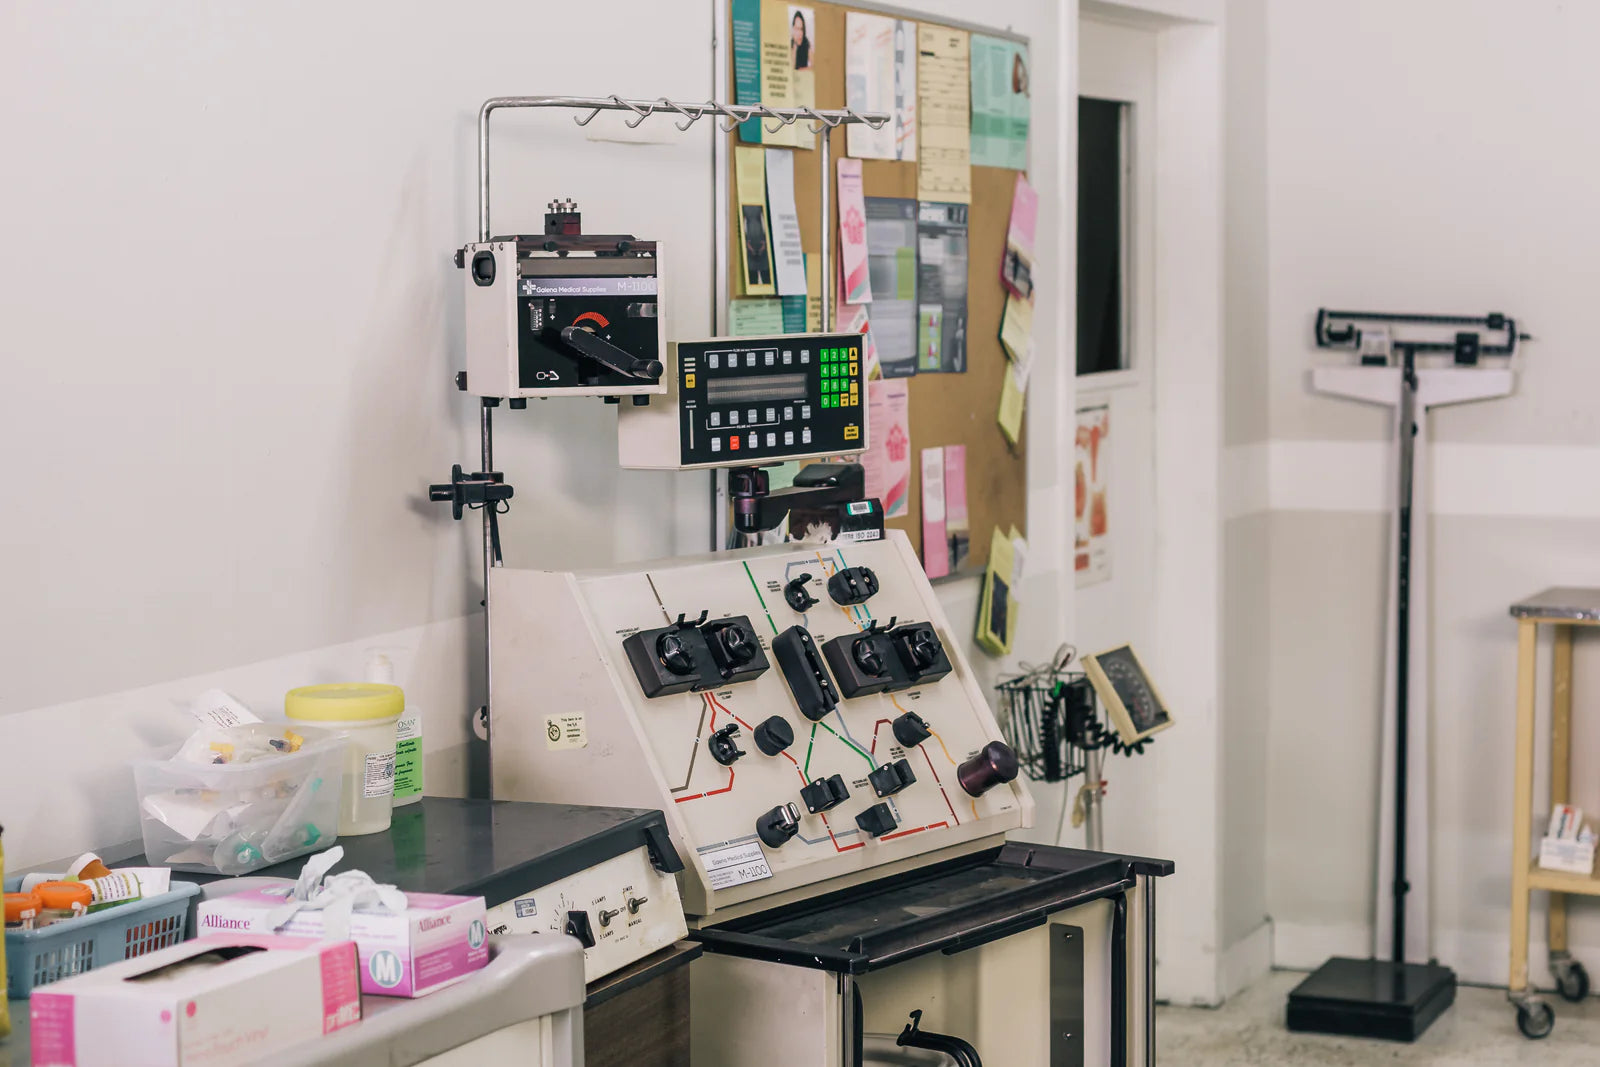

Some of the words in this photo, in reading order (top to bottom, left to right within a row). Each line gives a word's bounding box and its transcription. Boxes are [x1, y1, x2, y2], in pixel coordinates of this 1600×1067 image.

[582, 286, 606, 294] Supplies
[617, 281, 656, 292] M-1100
[832, 351, 837, 359] 2
[842, 350, 847, 358] 3
[832, 366, 837, 374] 5
[842, 365, 847, 373] 6
[833, 381, 838, 389] 8
[823, 397, 828, 405] 0
[727, 853, 744, 862] Medical
[738, 865, 767, 880] M-1100
[595, 896, 606, 904] LAMPS
[201, 914, 250, 930] Alliance
[418, 915, 452, 933] Alliance
[471, 921, 482, 944] M
[603, 930, 614, 938] LAMPS
[376, 953, 396, 982] M
